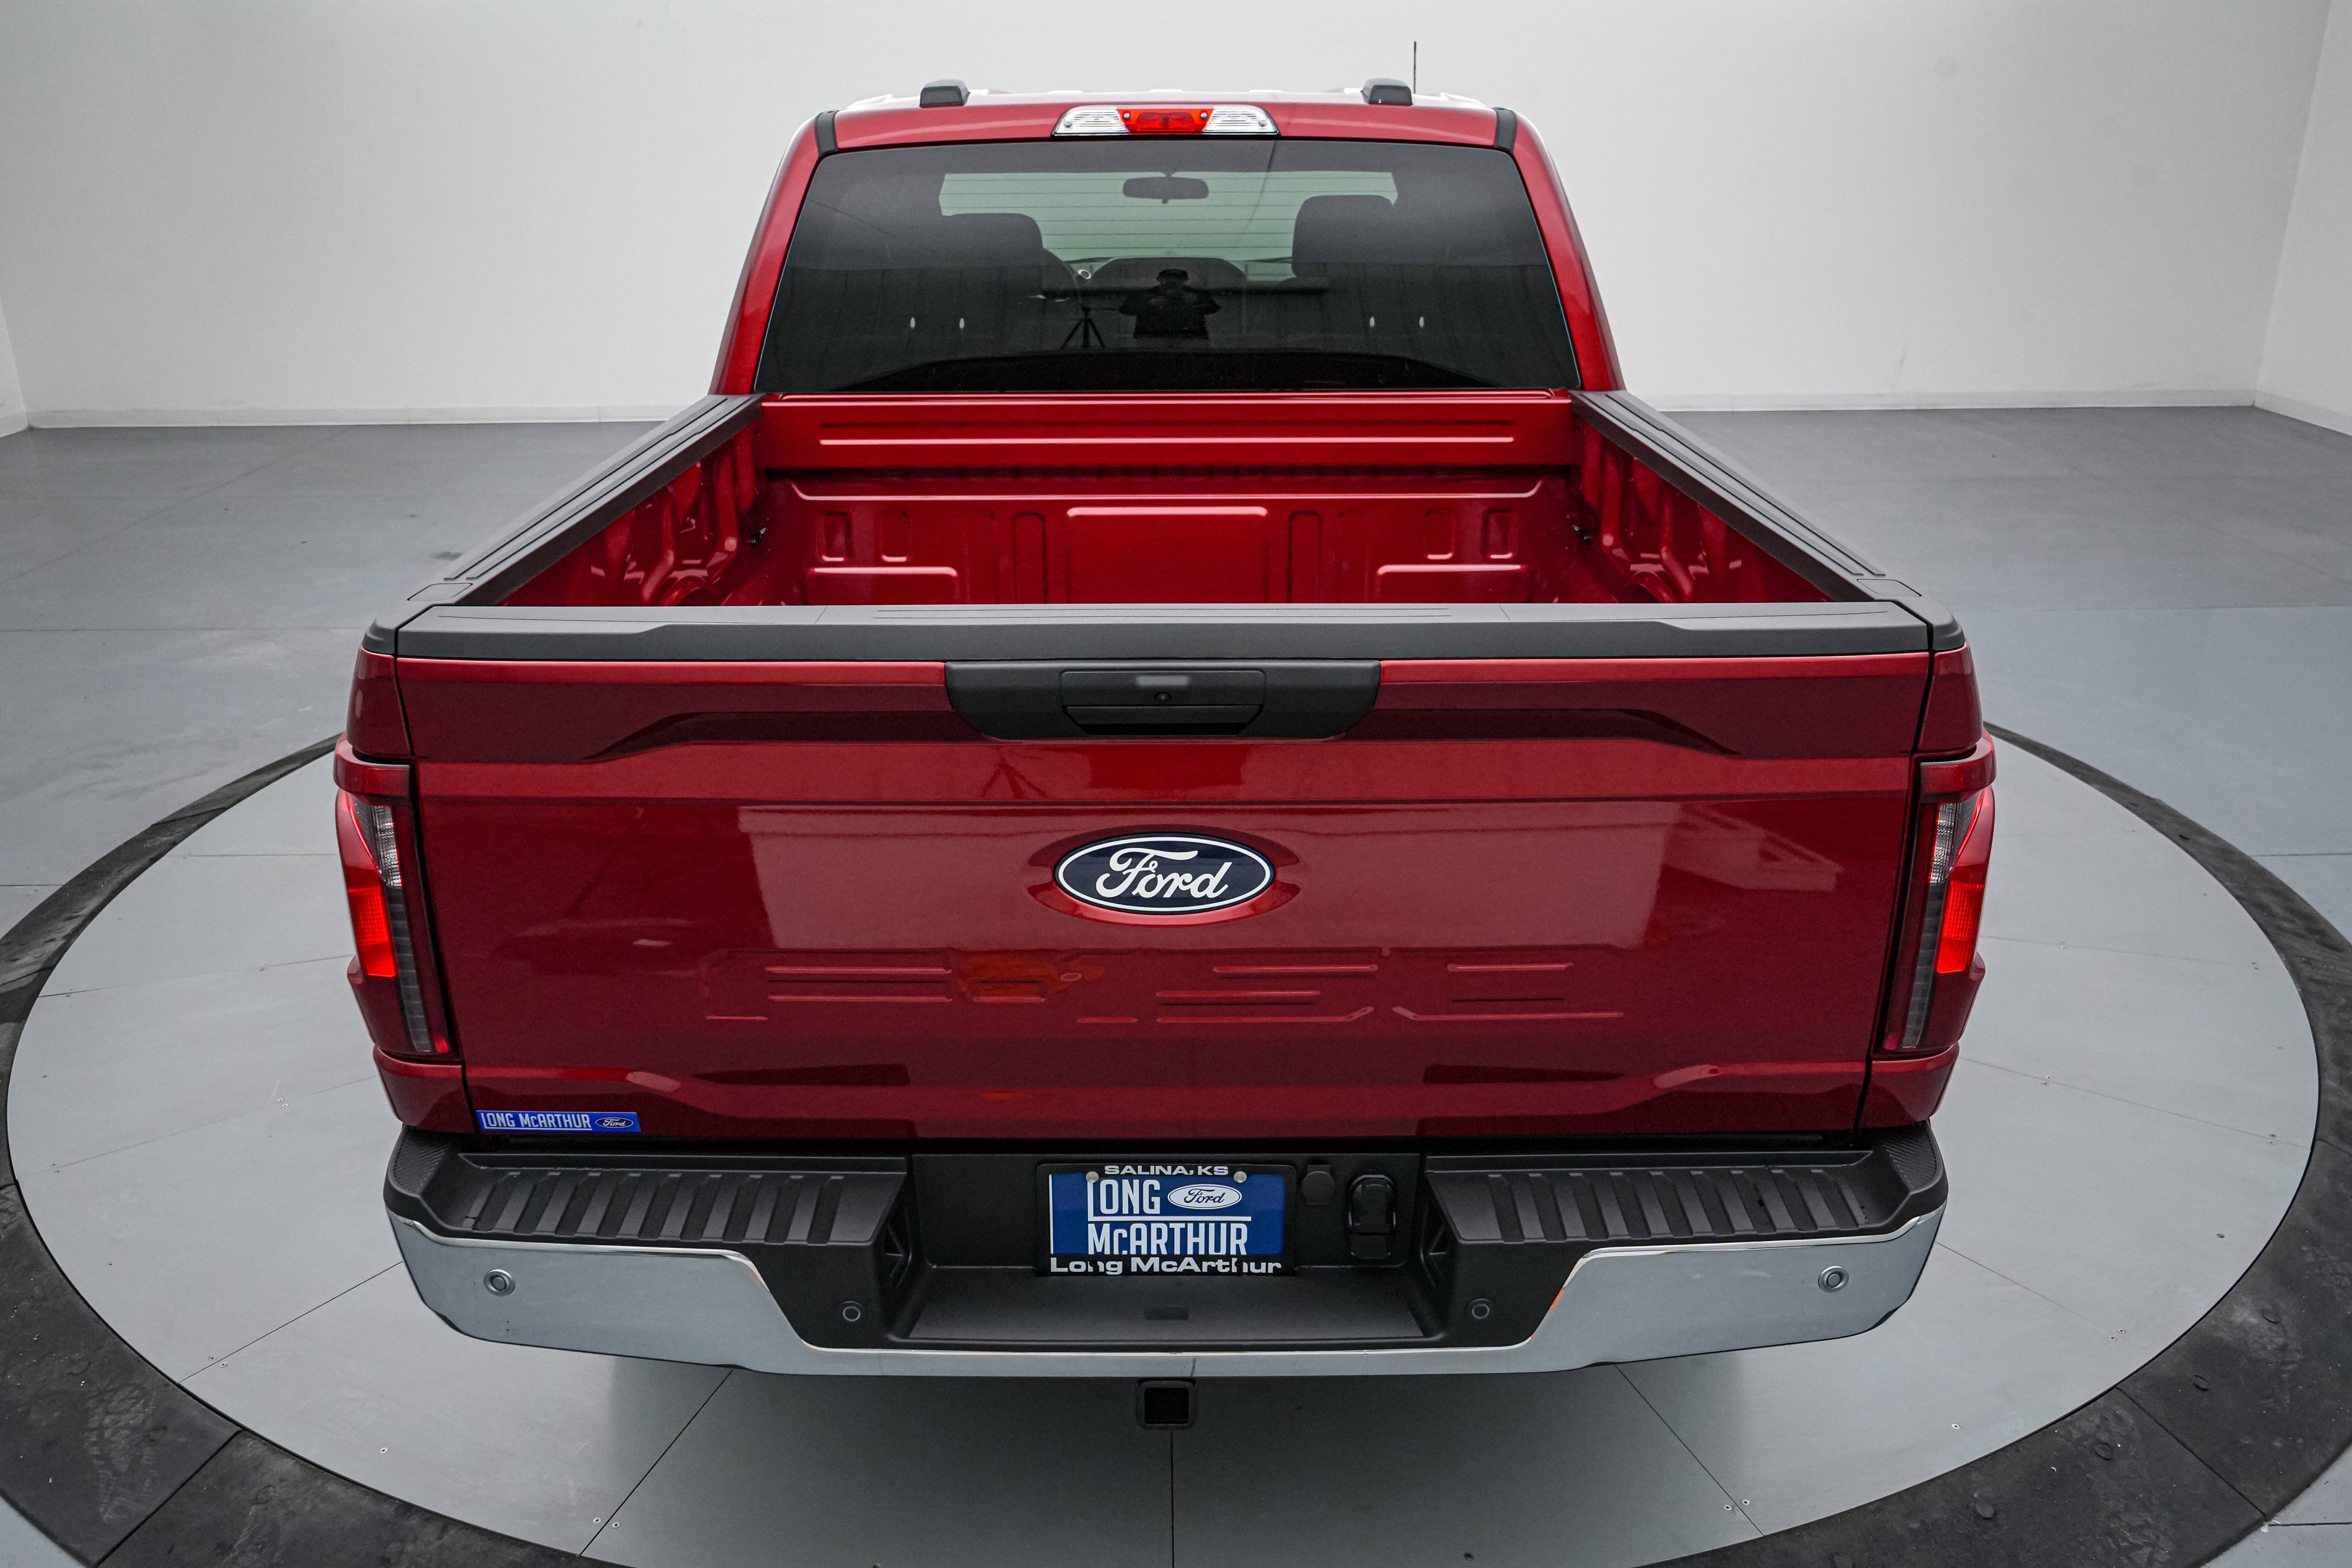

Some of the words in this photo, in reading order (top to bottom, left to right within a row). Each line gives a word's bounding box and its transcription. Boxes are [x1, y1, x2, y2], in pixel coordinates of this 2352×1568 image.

[1096, 847, 1232, 898] Ford
[481, 1113, 515, 1129] LONG
[519, 1114, 592, 1128] McARTHUR
[1105, 1165, 1194, 1175] SALINA,
[1198, 1166, 1228, 1175] KS
[1088, 1179, 1160, 1221] LONG
[1184, 1188, 1225, 1204] Ford
[1088, 1223, 1248, 1255] McARTHUR
[1051, 1257, 1123, 1275] Long
[1131, 1257, 1281, 1273] McArthur
